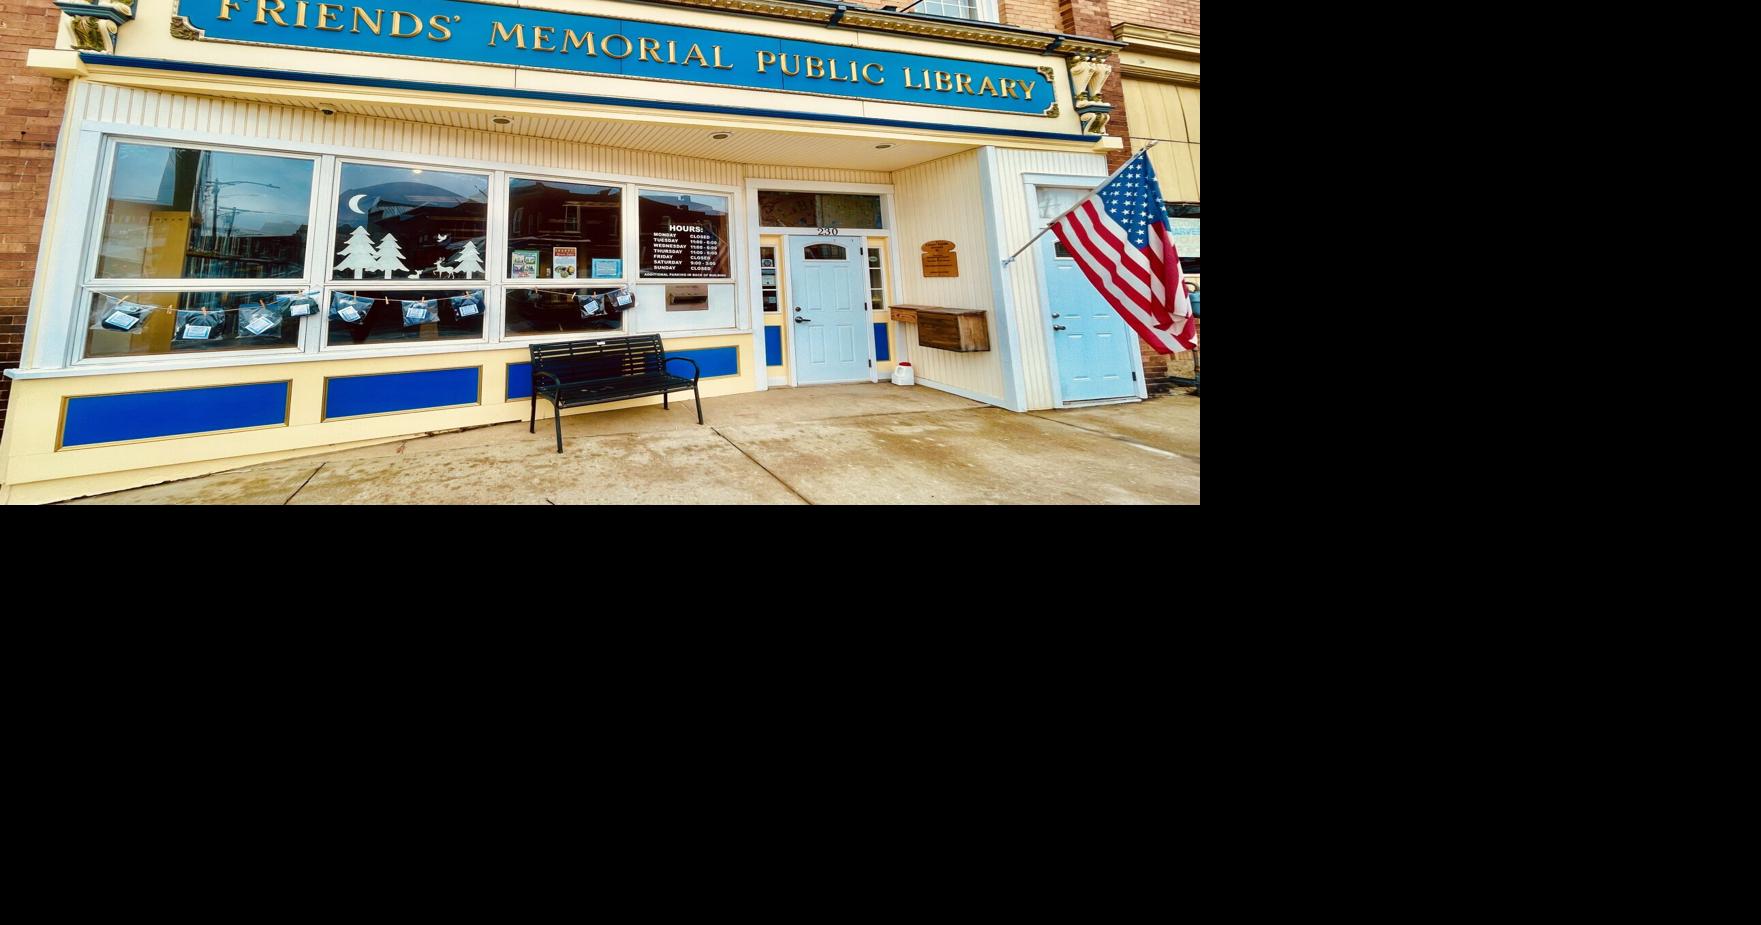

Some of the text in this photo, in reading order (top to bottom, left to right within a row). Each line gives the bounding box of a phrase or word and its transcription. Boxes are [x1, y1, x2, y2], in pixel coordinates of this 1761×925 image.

[216, 0, 1037, 102] FRIENDS' MEMORIAL PUBLIC LIBRARY
[817, 227, 839, 236] 230
